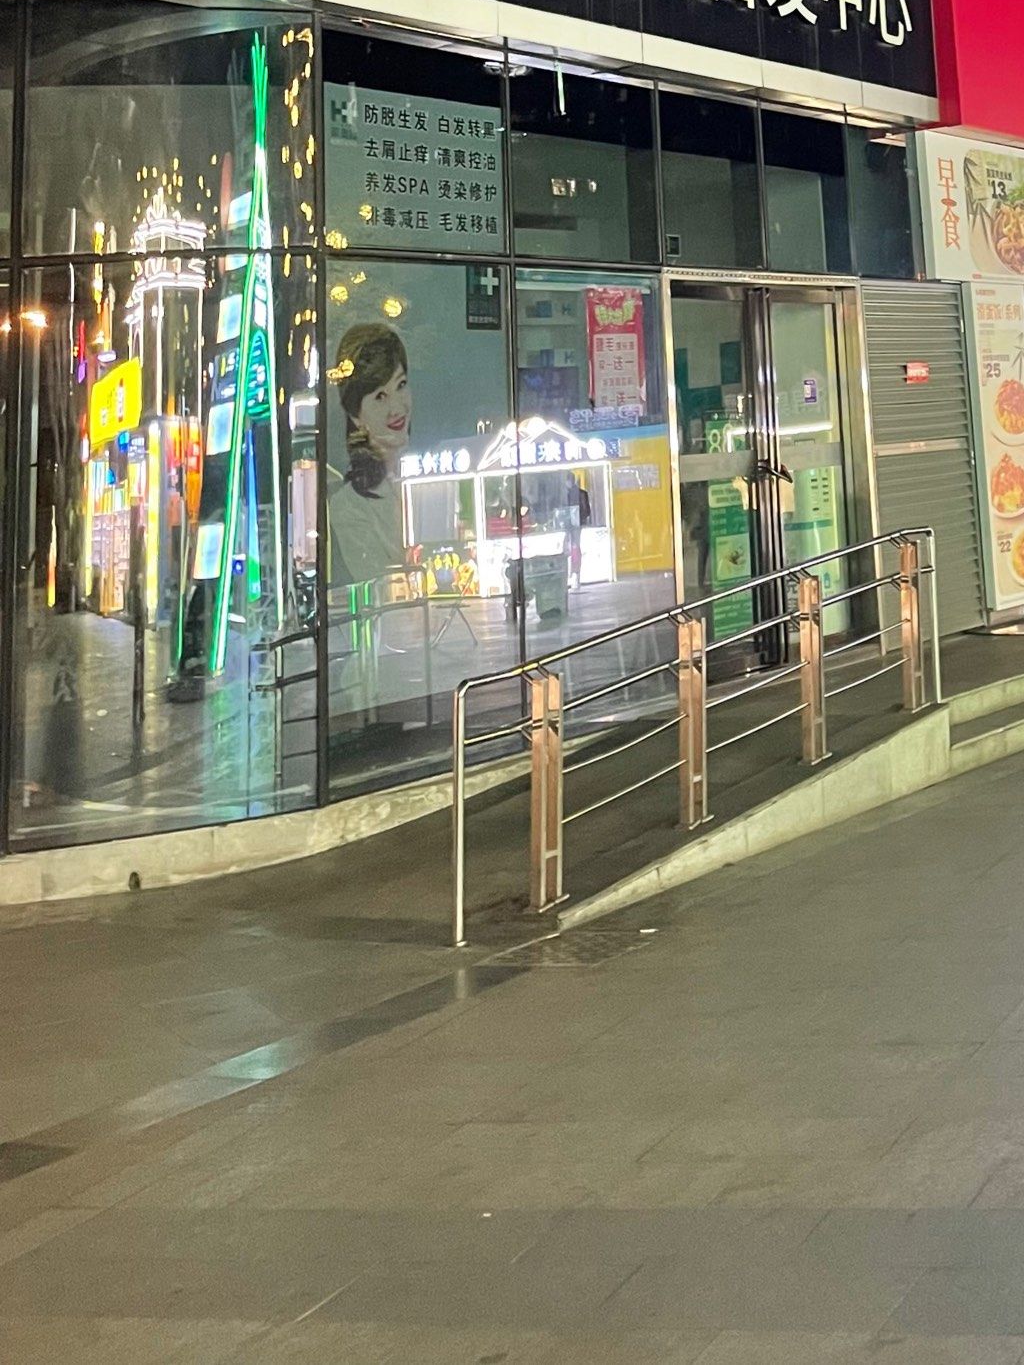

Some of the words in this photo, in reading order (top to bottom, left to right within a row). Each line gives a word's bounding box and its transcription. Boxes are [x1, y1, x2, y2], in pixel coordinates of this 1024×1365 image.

[364, 104, 428, 132] 防脱生发
[438, 115, 495, 140] 白发转黑
[364, 138, 428, 165] 去屑止痒
[437, 146, 496, 171] 清爽控油
[365, 171, 429, 195] 养发SPA
[438, 180, 497, 201] 烫染修护
[439, 213, 498, 234] 毛发移植
